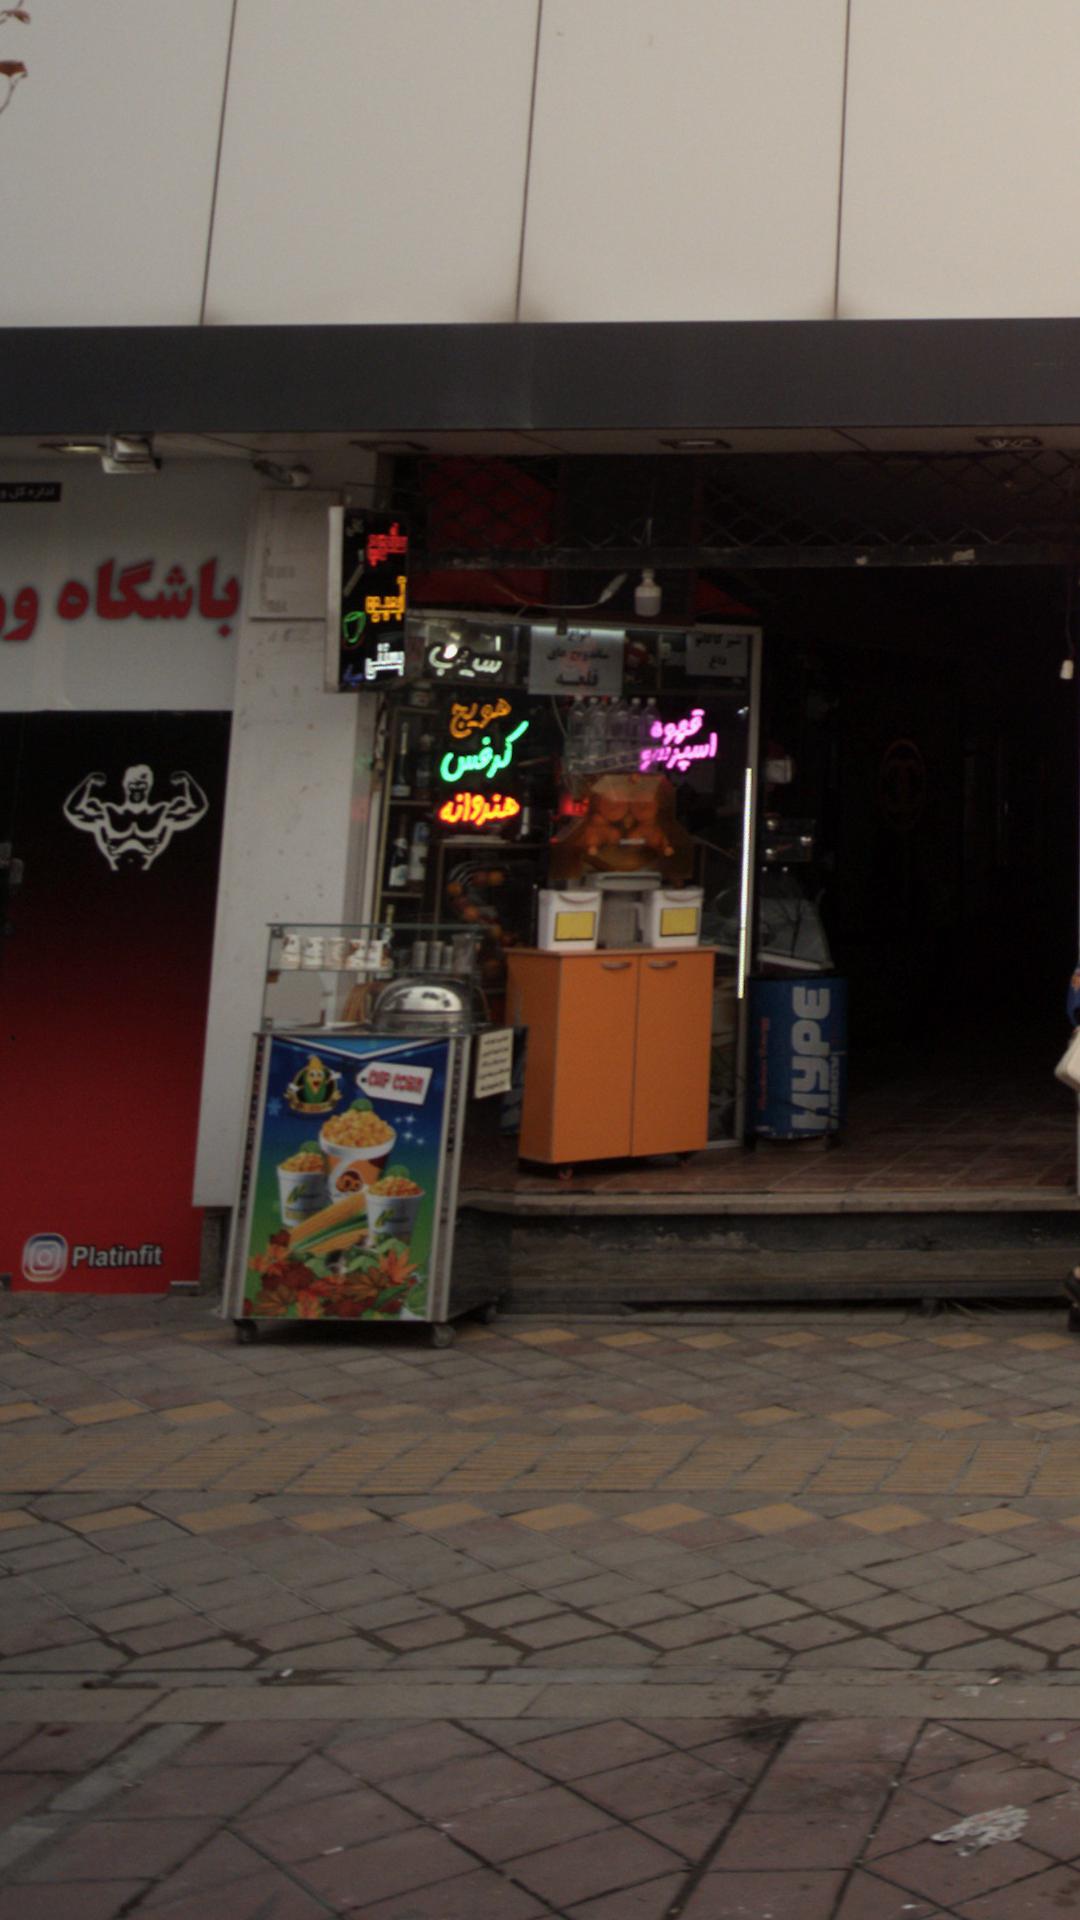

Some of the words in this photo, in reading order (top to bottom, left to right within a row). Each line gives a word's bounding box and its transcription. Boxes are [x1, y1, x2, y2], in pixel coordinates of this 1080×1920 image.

[0, 586, 37, 641] و
[57, 559, 240, 637] باشگاه
[428, 643, 503, 676] سیب
[449, 697, 513, 740] هویج
[649, 707, 706, 745] قهوه
[439, 719, 530, 783] کرفس
[437, 792, 522, 826] هندوانه
[790, 985, 831, 1130] HYPE
[71, 1244, 163, 1268] Platinfit
